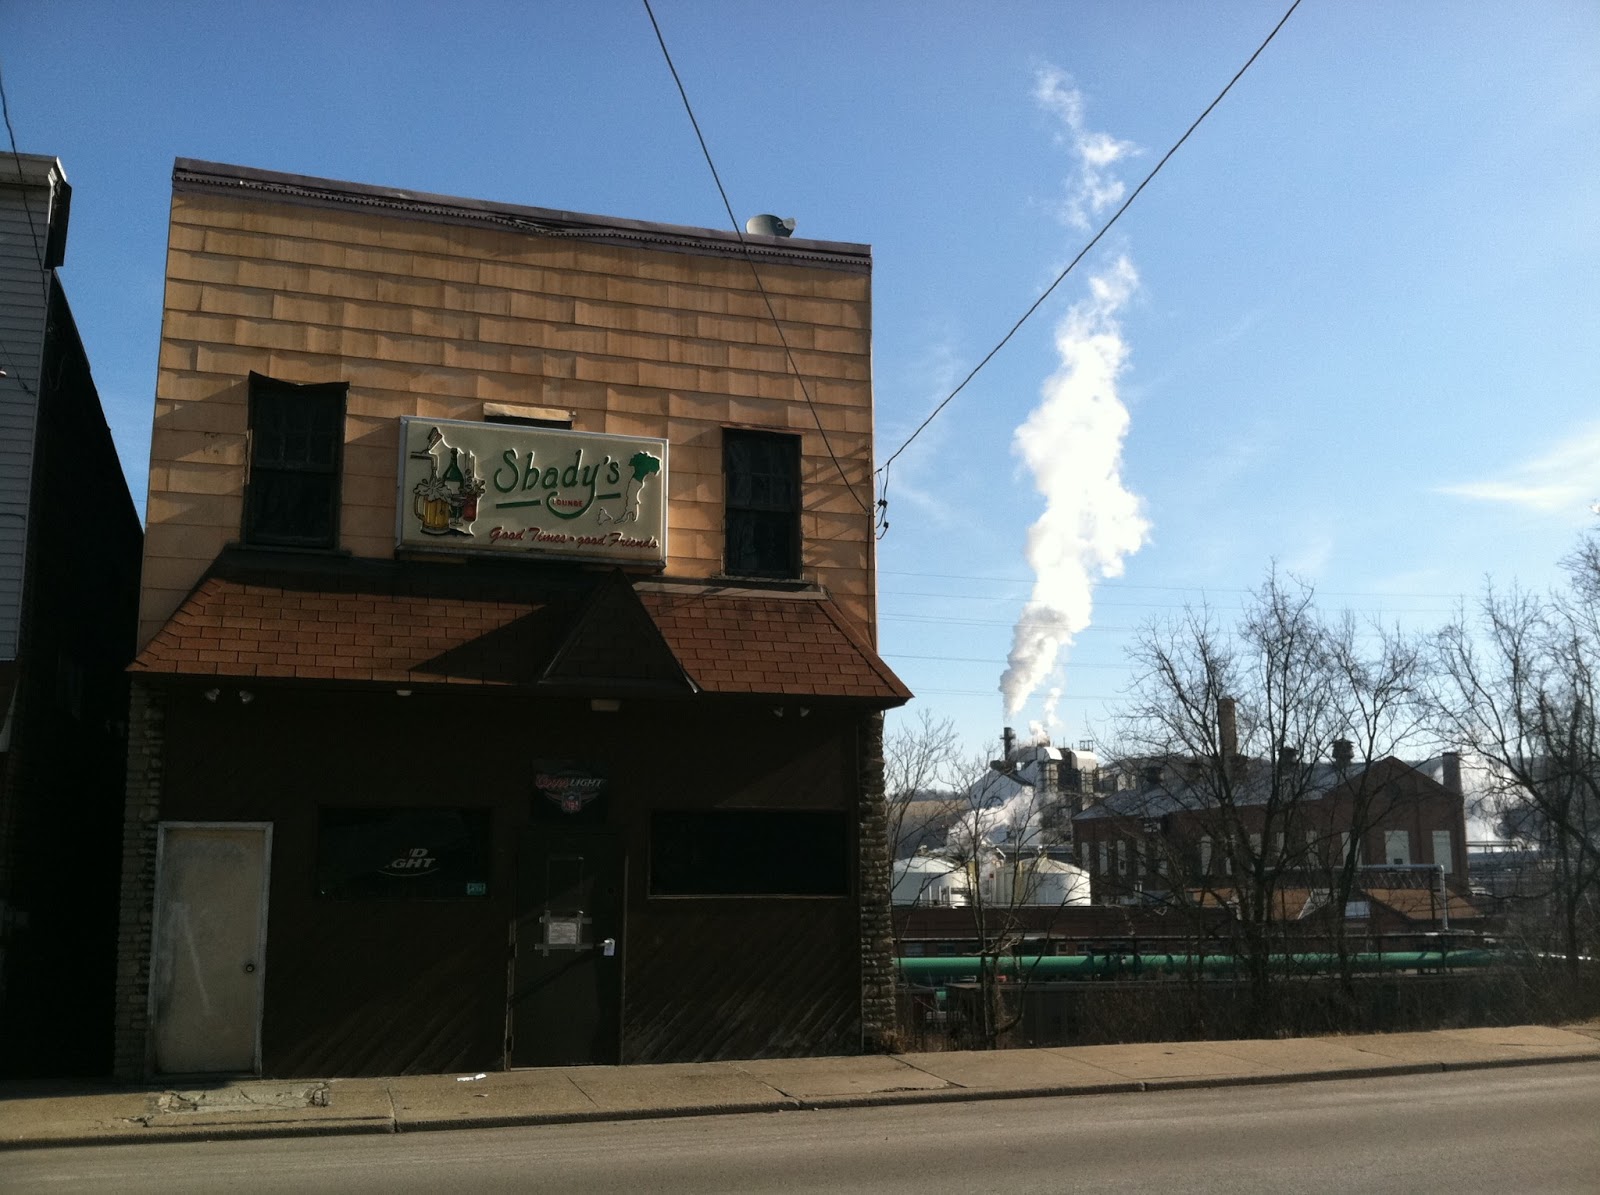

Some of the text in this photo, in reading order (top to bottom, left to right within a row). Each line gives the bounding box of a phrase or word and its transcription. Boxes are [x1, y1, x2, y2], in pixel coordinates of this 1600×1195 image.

[493, 447, 621, 519] Shady's
[552, 498, 583, 508] LOUNGE
[489, 526, 660, 550] Good Times good Friends
